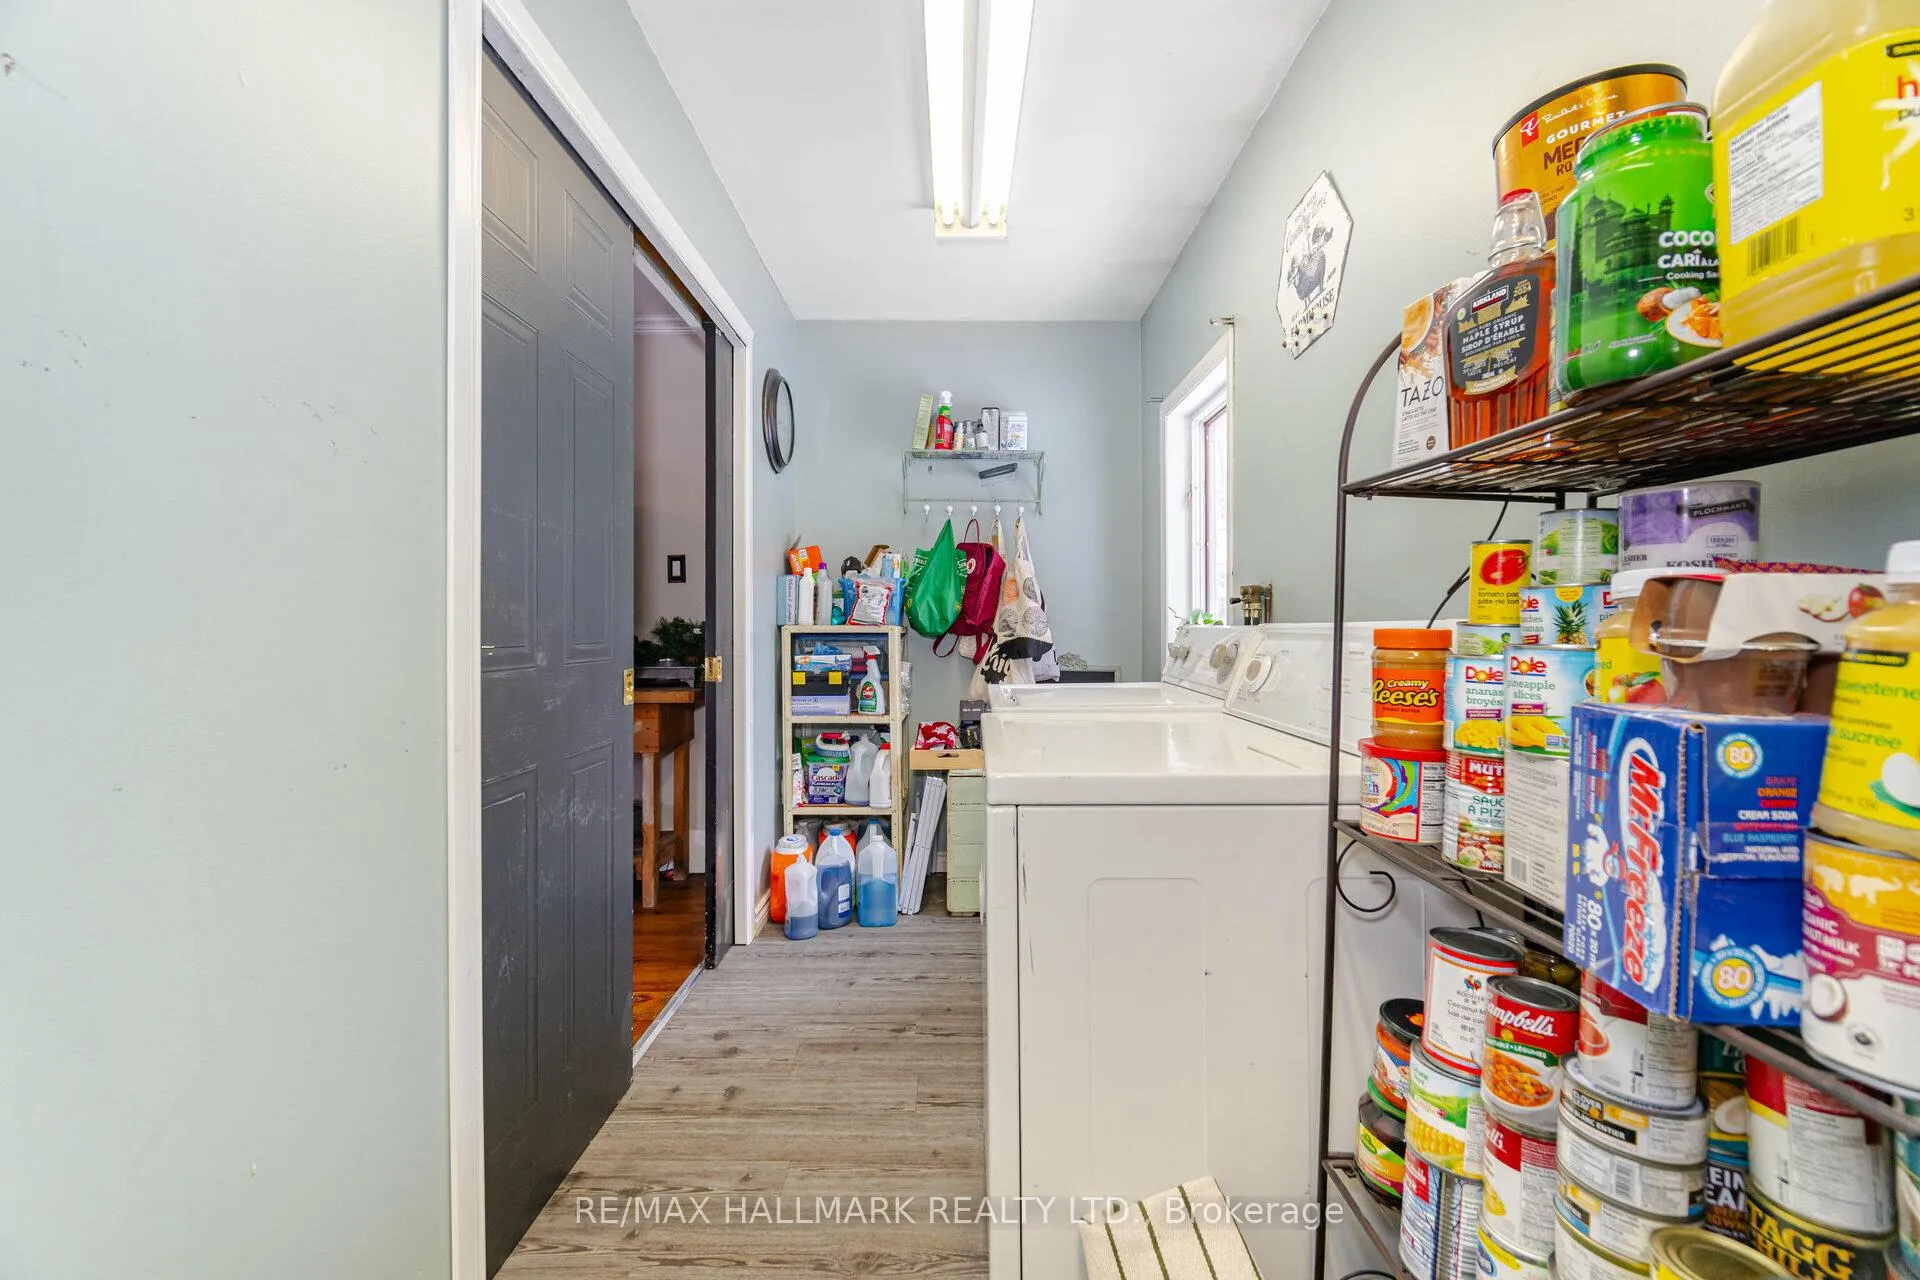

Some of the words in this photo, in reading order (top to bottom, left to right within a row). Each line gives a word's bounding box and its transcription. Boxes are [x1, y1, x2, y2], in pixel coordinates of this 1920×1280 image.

[1545, 110, 1626, 144] GOURMET
[1556, 160, 1573, 177] RO
[1658, 230, 1715, 248] COCO
[1665, 271, 1705, 280] Cooking
[1472, 288, 1507, 308] KIRKLAND
[1462, 327, 1490, 344] MAPLE
[1493, 314, 1524, 332] SYRUP
[1461, 338, 1484, 354] SIROP
[1484, 322, 1526, 346] D'ÉRABLE
[1401, 375, 1445, 408] TAZO
[1624, 553, 1648, 561] ASHER
[1665, 559, 1714, 568] KOSH
[1520, 595, 1539, 611] ole
[1511, 656, 1547, 673] Dole
[1466, 665, 1504, 682] Dole
[1373, 678, 1440, 707] Reese's
[1466, 687, 1505, 697] ananas
[1507, 680, 1556, 691] pineapple
[1466, 697, 1504, 707] broyés
[1513, 690, 1542, 700] slices
[1729, 746, 1755, 764] 80
[811, 773, 842, 782] Cascade
[1469, 762, 1504, 776] MUT
[1757, 787, 1798, 797] ORANGE
[1473, 795, 1505, 807] SAUC
[1480, 807, 1505, 819] PIZ
[1737, 809, 1770, 820] CREAM
[1770, 810, 1799, 821] SODA
[1623, 820, 1663, 985] Freeze
[1587, 899, 1603, 931] 80
[1718, 965, 1752, 990] 80
[1447, 999, 1478, 1013] Coconut
[1488, 1003, 1555, 1037] ampbell's
[1747, 1200, 1856, 1280] TAGG
